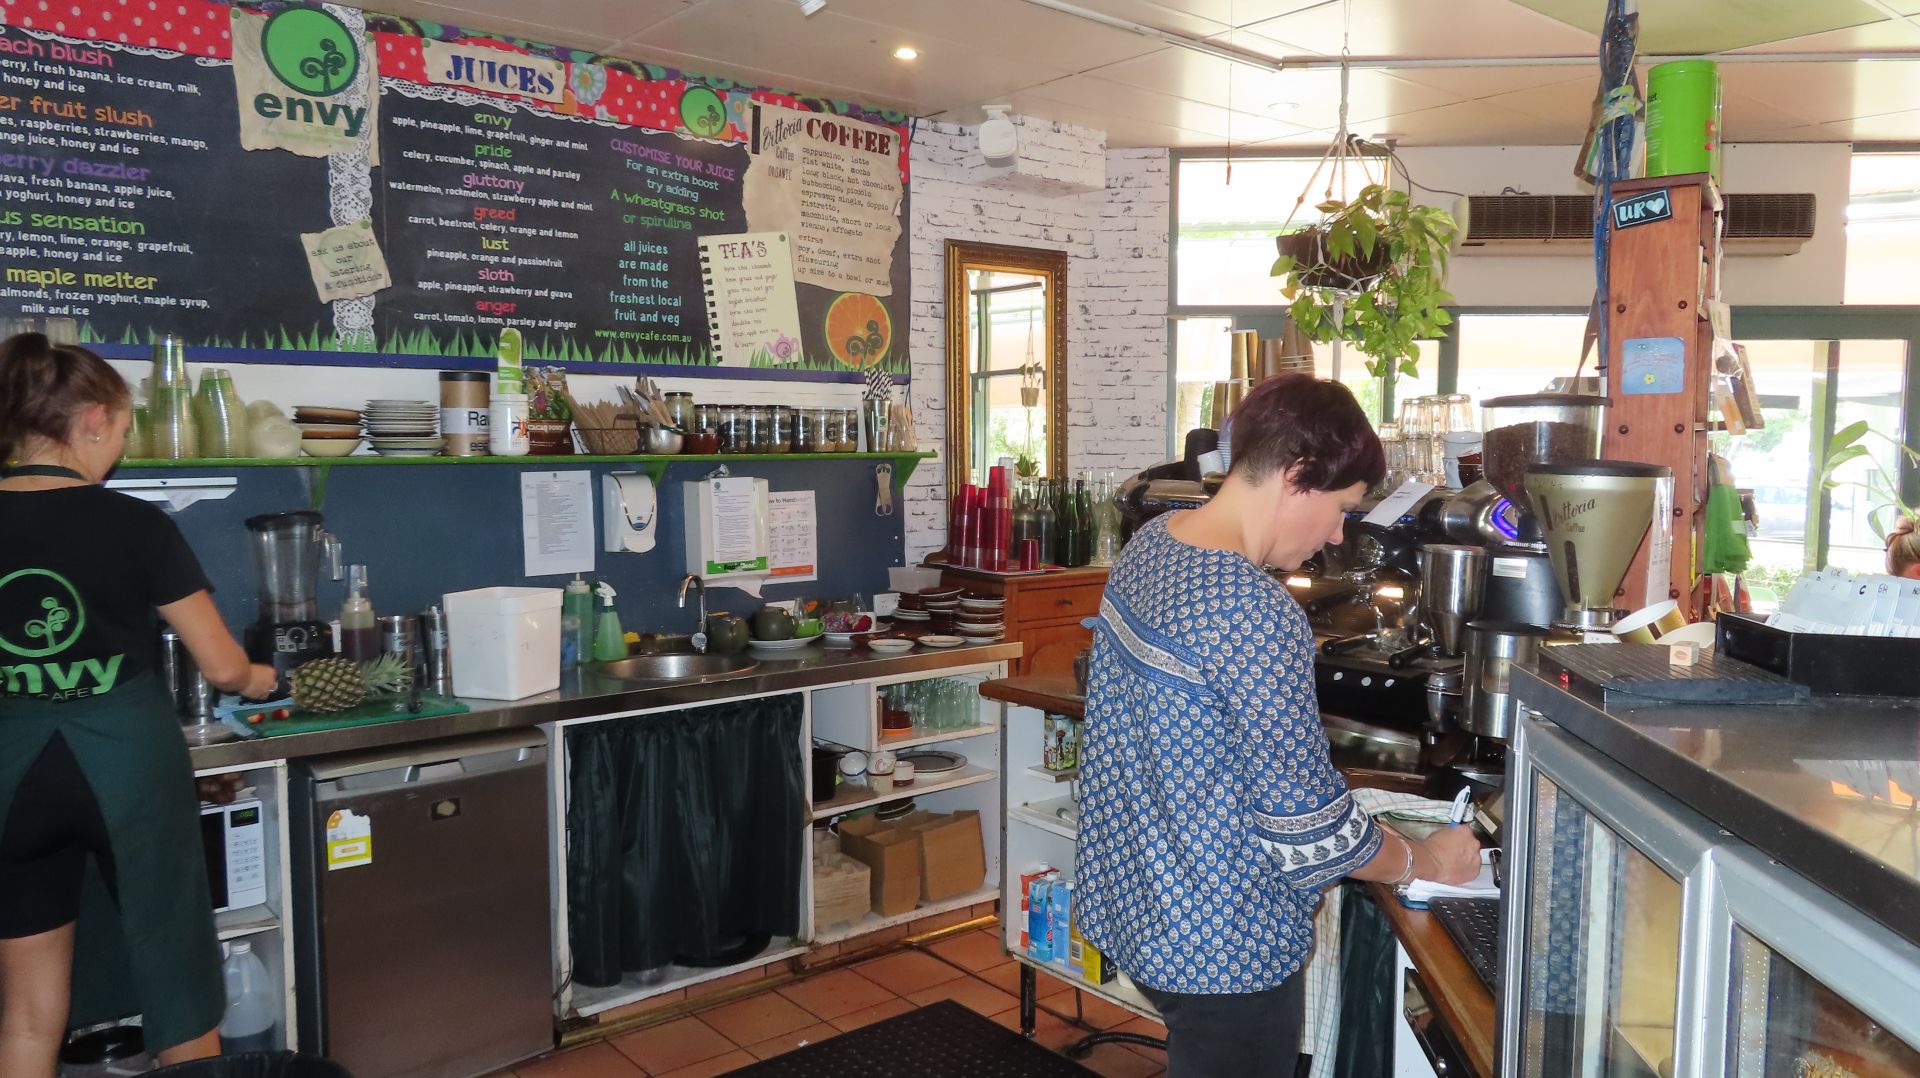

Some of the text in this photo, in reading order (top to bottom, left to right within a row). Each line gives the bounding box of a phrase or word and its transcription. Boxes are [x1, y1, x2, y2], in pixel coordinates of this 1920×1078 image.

[52, 43, 113, 67] blush
[0, 59, 201, 96] erry, fresh banana, ice cream, milk,
[4, 72, 86, 93] honey and ice
[446, 55, 555, 95] JUICES
[30, 95, 87, 119] fruit
[94, 104, 153, 128] slush
[254, 92, 366, 138] envy
[474, 112, 512, 130] envy
[20, 119, 92, 137] raspberries,
[94, 127, 168, 145] strawberries,
[171, 137, 209, 150] mango,
[392, 115, 588, 151] apple, pineapple, lime, grapefruit, ginger and mint
[806, 117, 891, 156] COFFEE
[28, 133, 59, 147] juice,
[61, 137, 96, 153] honey
[100, 142, 119, 154] and
[123, 144, 140, 155] ice
[474, 144, 513, 158] pride
[776, 147, 794, 161] Coffee
[63, 158, 150, 181] dazzler
[403, 150, 581, 182] celery, cucumber, spinach, apple and parsley
[610, 138, 736, 181] CUSTOMISE YOUR JUICE
[463, 172, 525, 194] gluttony
[626, 159, 720, 191] For an extra boost
[768, 165, 793, 181] ORGANIC
[31, 174, 63, 188] fresh
[67, 179, 110, 193] banana,
[114, 184, 143, 200] apple
[147, 186, 175, 200] juice,
[389, 180, 593, 212] watermelon, rockmelon, strawberry apple and mint
[647, 179, 699, 203] try adding
[6, 189, 135, 209] yoghurt, honey and ice
[610, 189, 725, 222] A wheatgrass shot
[31, 212, 145, 235] sensation
[474, 207, 517, 221] greed
[623, 214, 694, 231] or spirulina
[408, 214, 579, 240] carrot, beetroot, celery, orange and lemon
[18, 231, 57, 244] lemon,
[60, 234, 88, 247] lime,
[91, 238, 132, 251] orange,
[138, 242, 193, 255] grapefruit,
[481, 237, 510, 251] lust
[624, 240, 669, 255] all juices
[718, 241, 767, 259] TEA'S
[44, 249, 79, 264] honey
[82, 251, 102, 262] and
[106, 252, 123, 263] ice
[427, 249, 564, 268] pineapple, orange and passionfruit
[618, 259, 669, 272] are made
[6, 267, 158, 290] maple melter
[478, 268, 515, 282] sloth
[623, 274, 669, 289] from the
[0, 288, 210, 309] almonds, frozen yoghurt, maple syrup,
[417, 280, 573, 300] apple, pineapple, strawberry and guava
[609, 291, 682, 307] freshest local
[21, 303, 89, 315] milk and ice
[476, 300, 517, 315] anger
[615, 308, 680, 327] fruit and veg
[414, 312, 577, 330] carrot, tomato, lemon, parsley and ginger
[594, 329, 692, 343] www.envycafe.com.au
[468, 410, 489, 426] Ra
[0, 653, 125, 694] nvy
